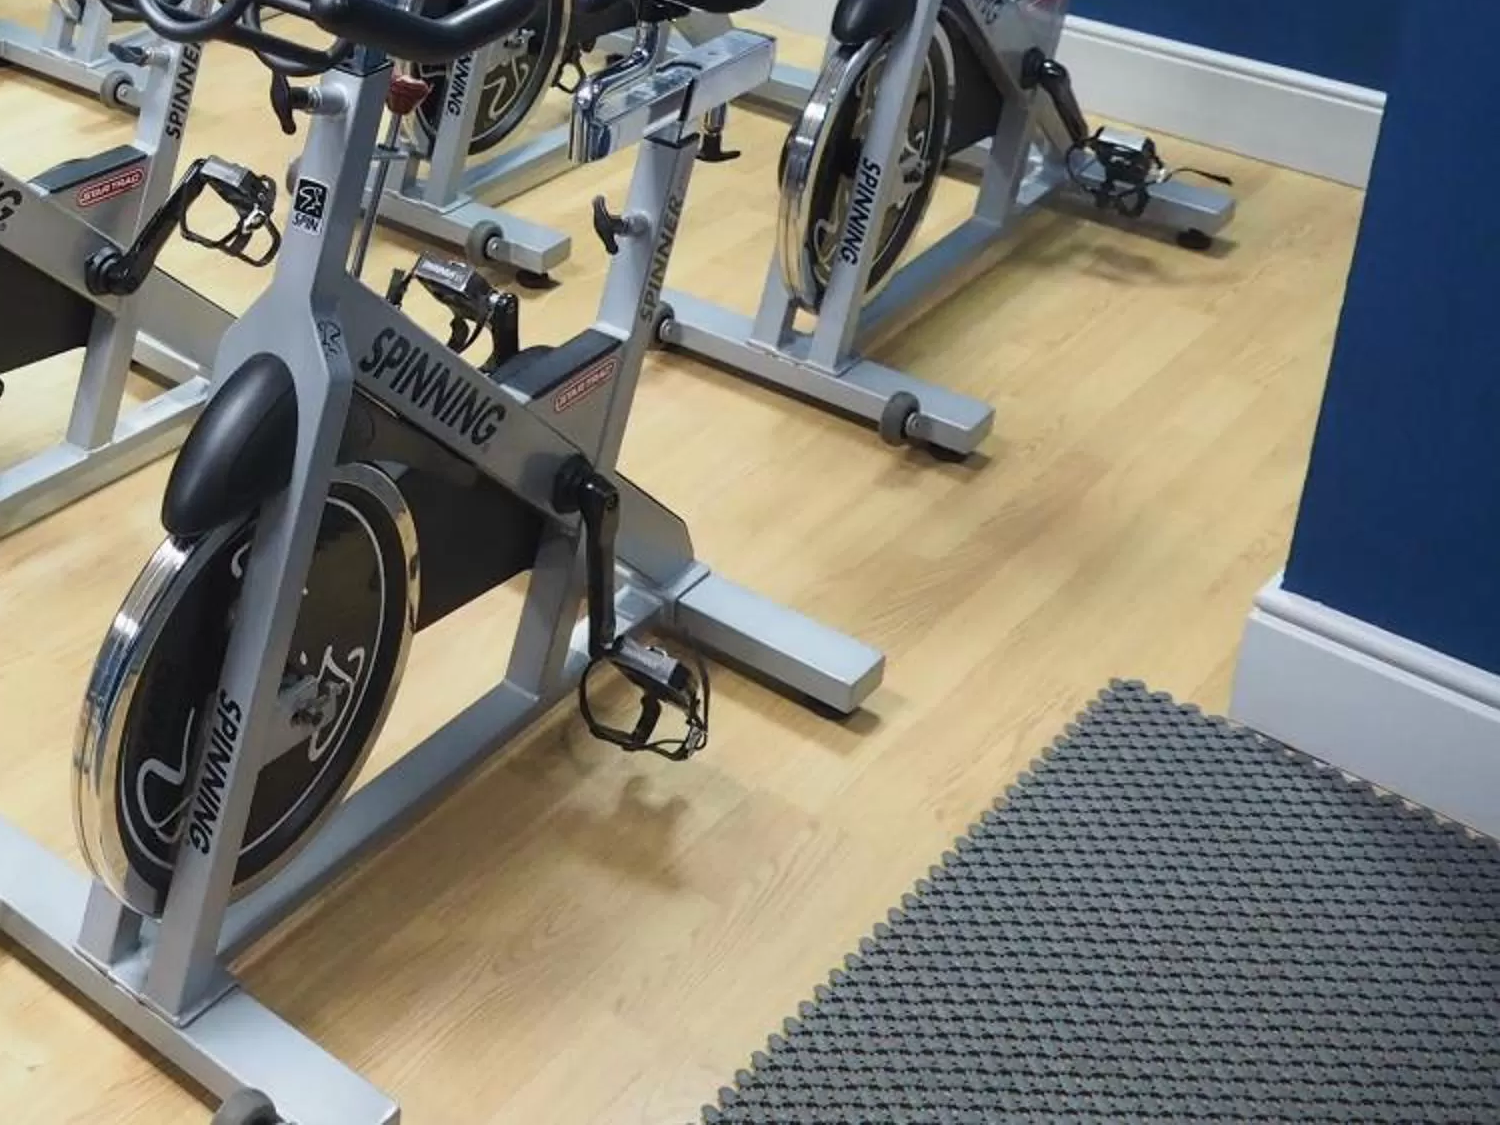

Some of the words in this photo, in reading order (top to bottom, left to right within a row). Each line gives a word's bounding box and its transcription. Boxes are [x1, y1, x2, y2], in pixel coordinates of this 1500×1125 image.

[640, 194, 684, 323] SPINNER
[840, 156, 881, 265] SPINNING
[358, 326, 506, 445] SPINNING
[187, 686, 245, 856] SPINNING
